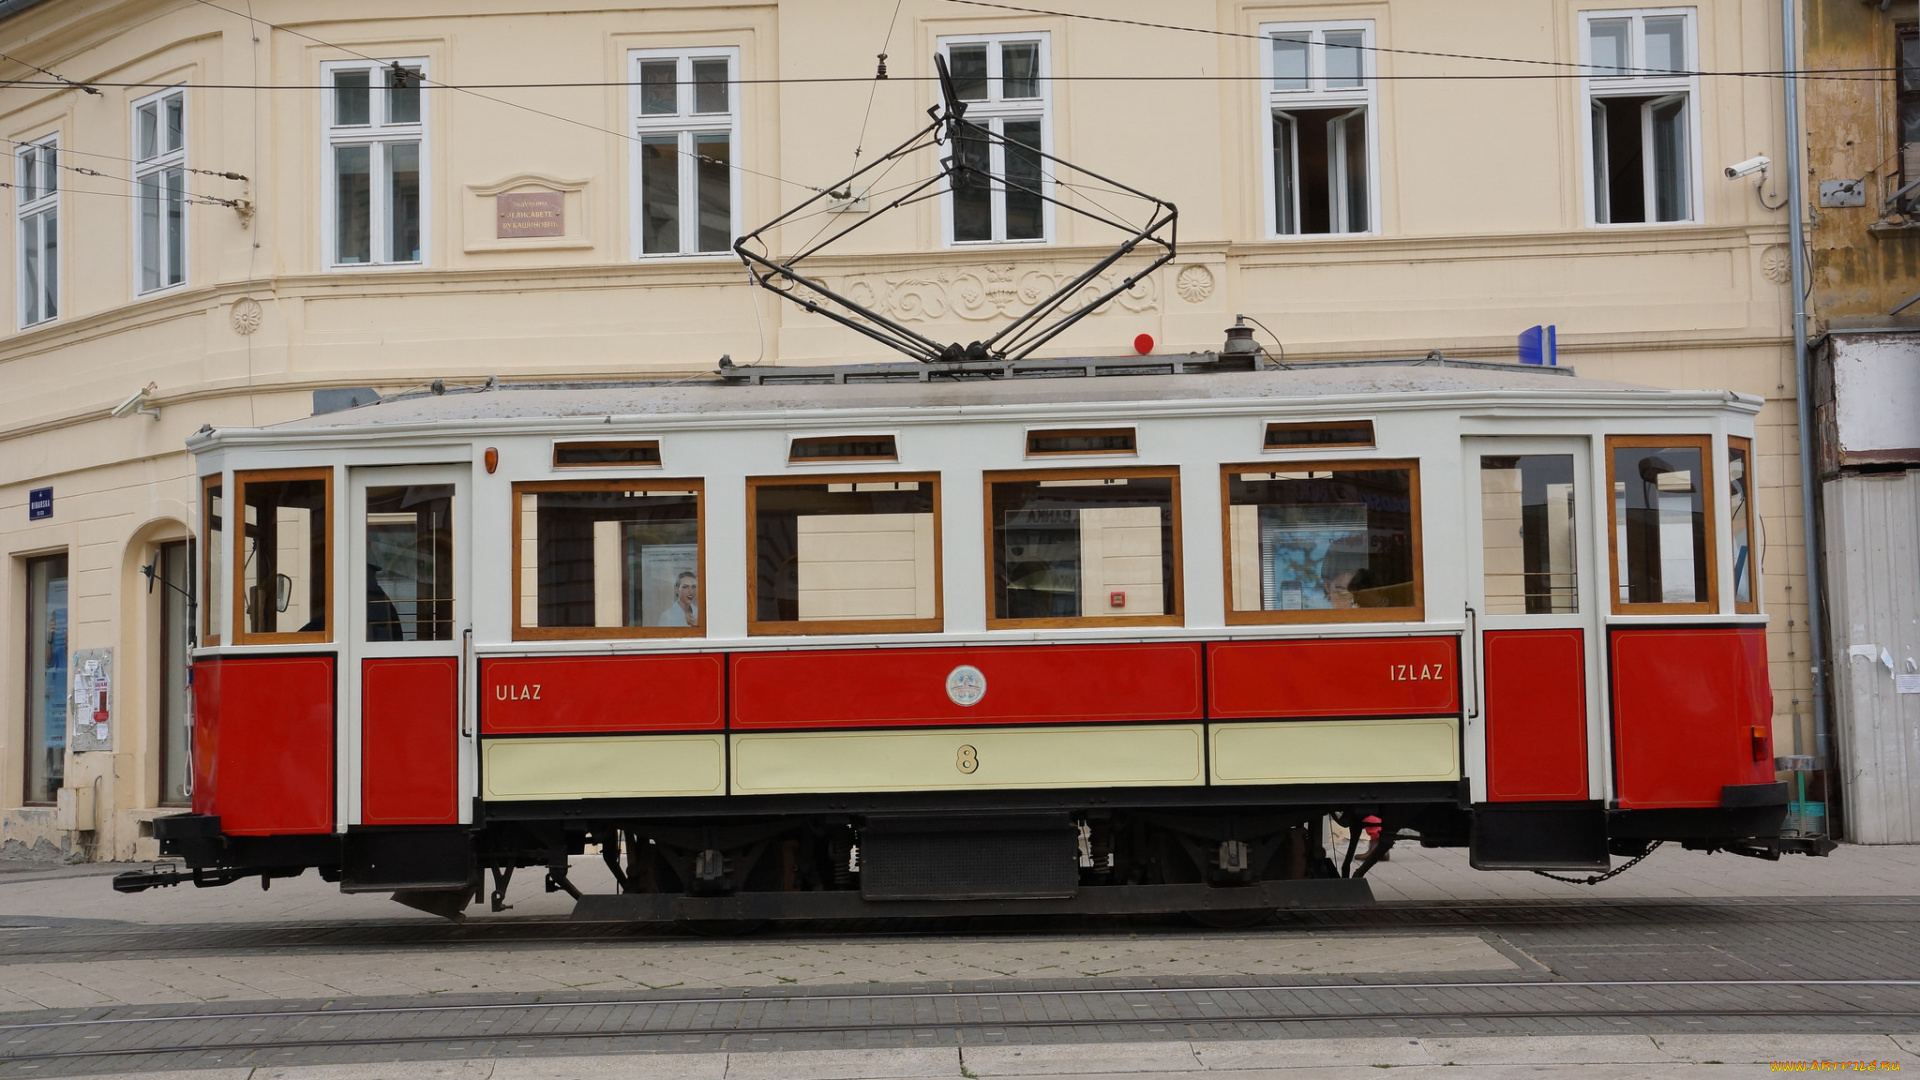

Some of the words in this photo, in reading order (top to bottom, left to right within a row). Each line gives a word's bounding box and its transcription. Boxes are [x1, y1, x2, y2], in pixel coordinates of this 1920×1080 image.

[1391, 664, 1443, 681] IZLAZ
[496, 684, 541, 701] ULAZ
[956, 744, 979, 775] 8
